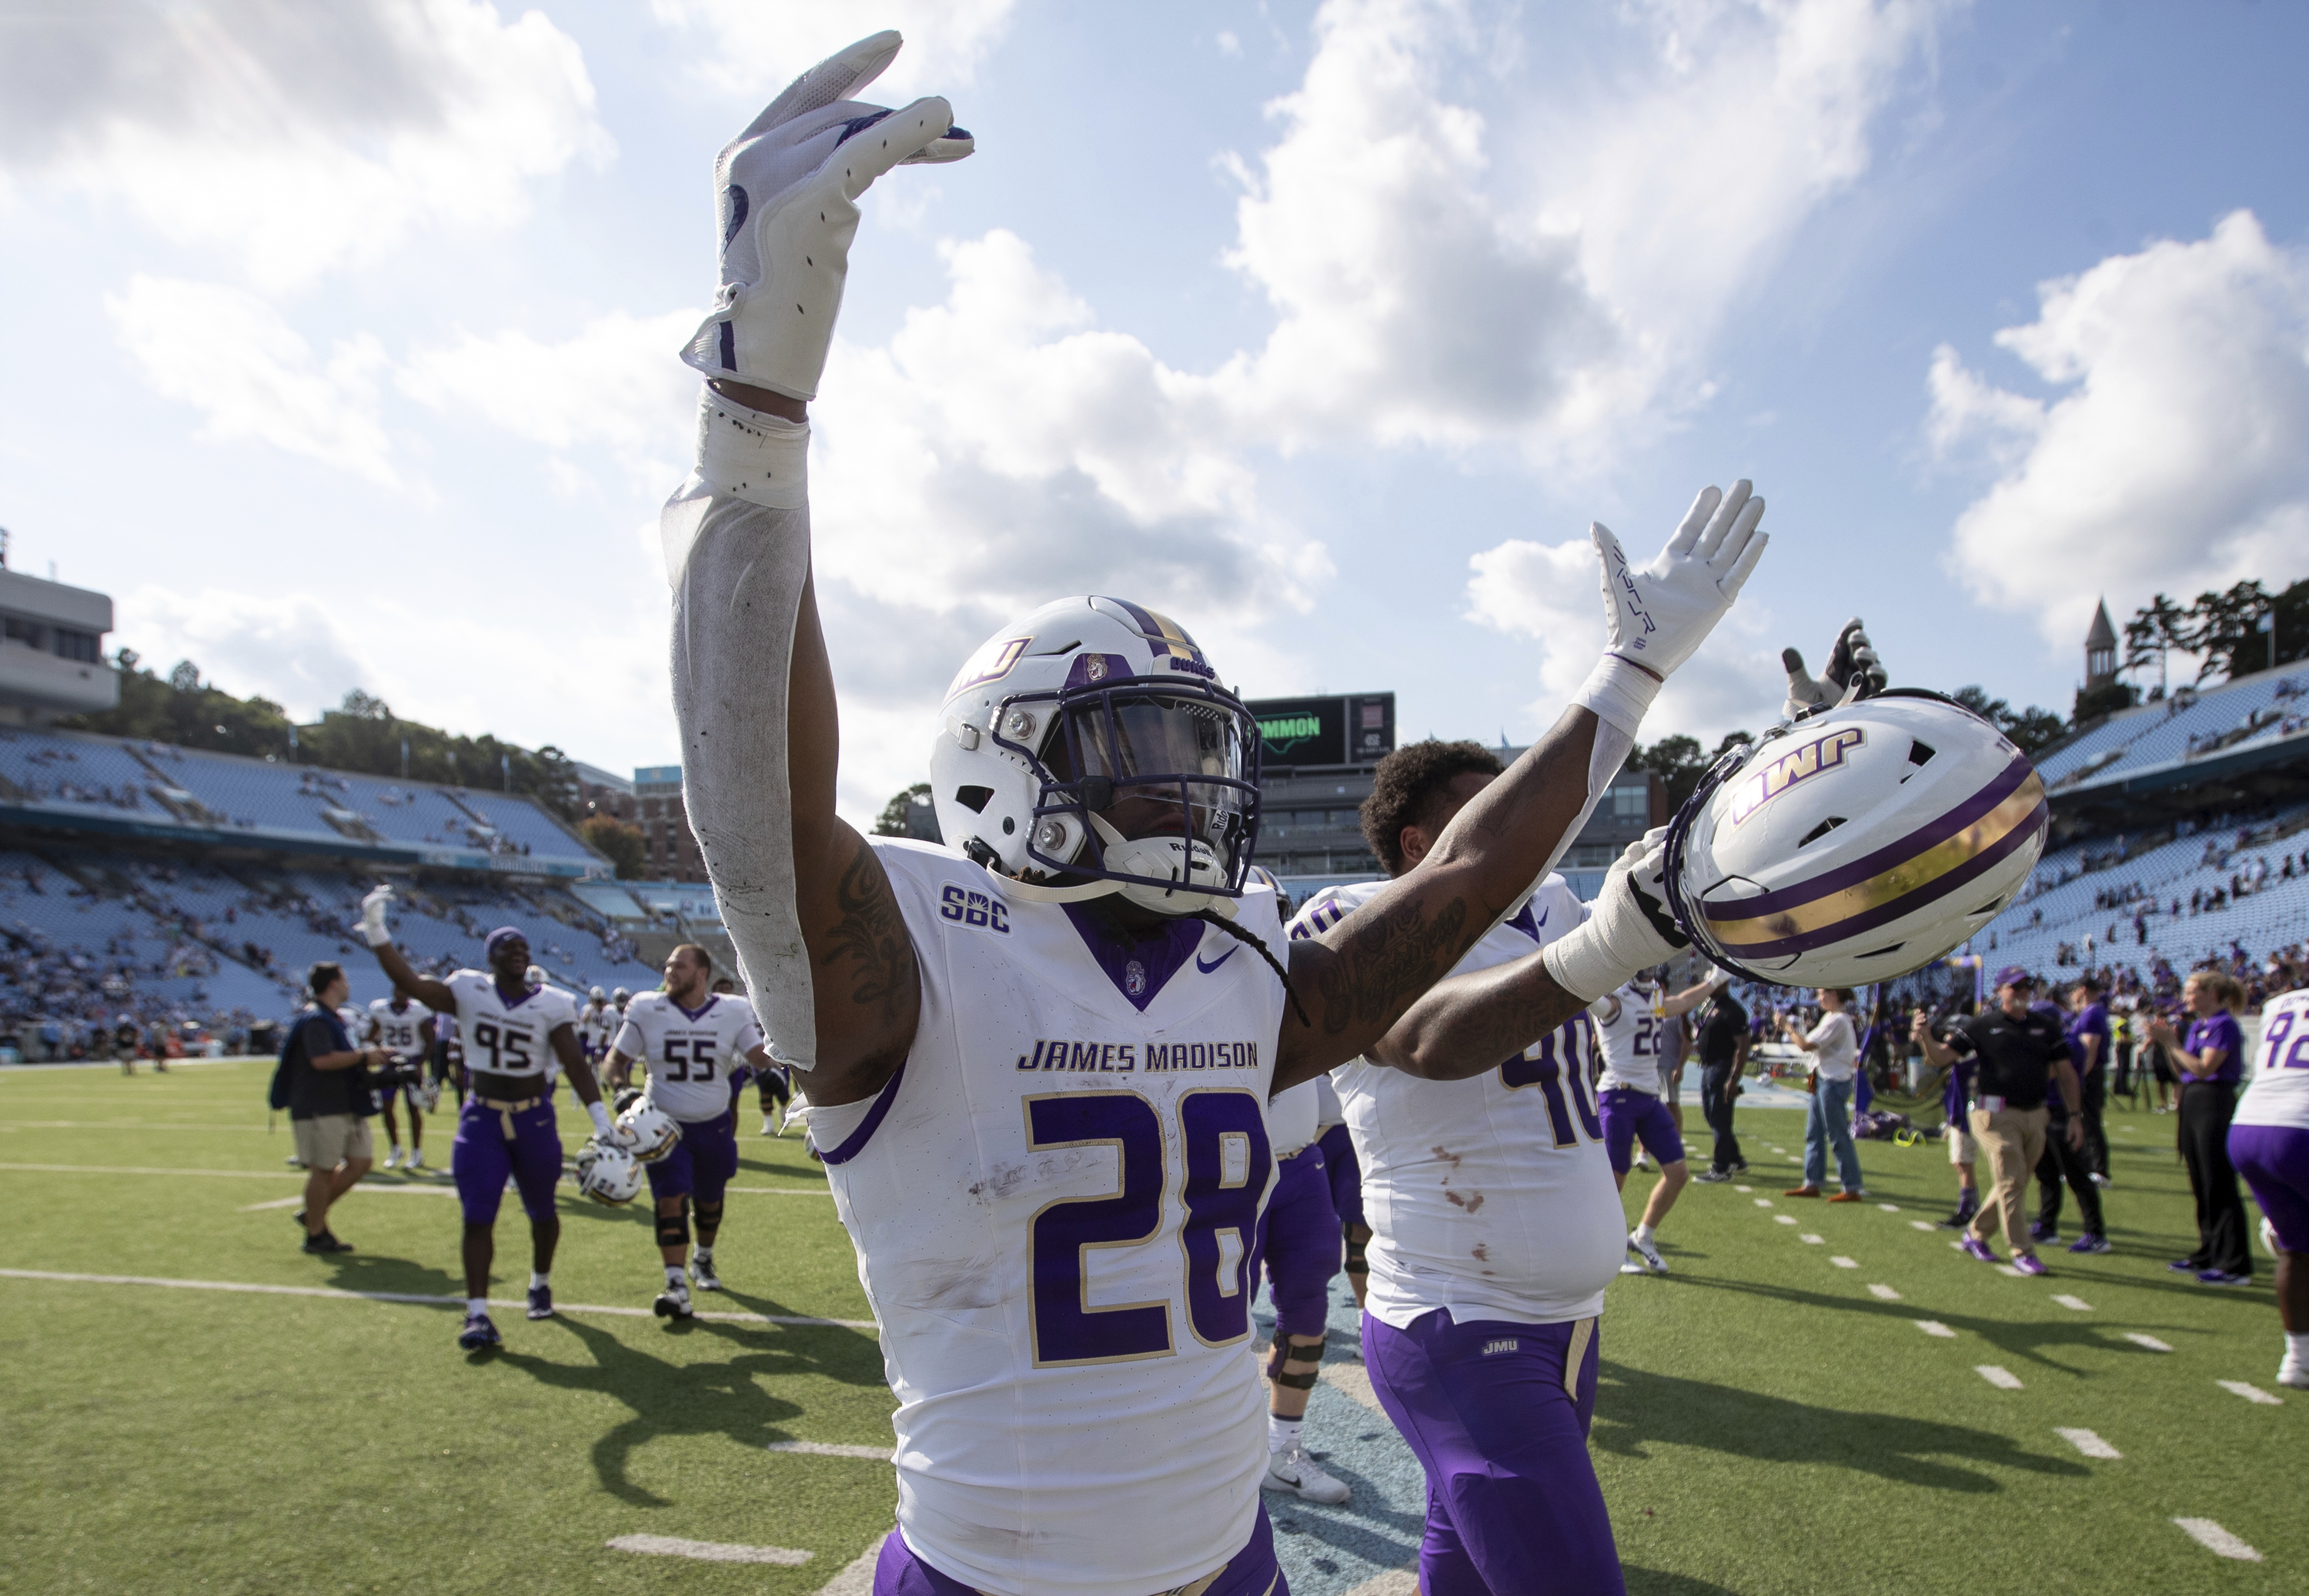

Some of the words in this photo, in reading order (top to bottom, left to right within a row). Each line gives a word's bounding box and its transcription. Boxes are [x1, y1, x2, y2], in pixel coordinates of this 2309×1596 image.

[1170, 656, 1215, 679] DUKES
[940, 884, 1011, 933] SBC
[476, 1023, 533, 1069] 95
[1015, 1039, 1135, 1073] JAMES
[1144, 1041, 1258, 1072] MADISON
[1633, 1017, 1662, 1056] 22
[663, 1039, 717, 1082] 55
[1021, 1087, 1274, 1369] 28
[1482, 1339, 1519, 1356] JMU
